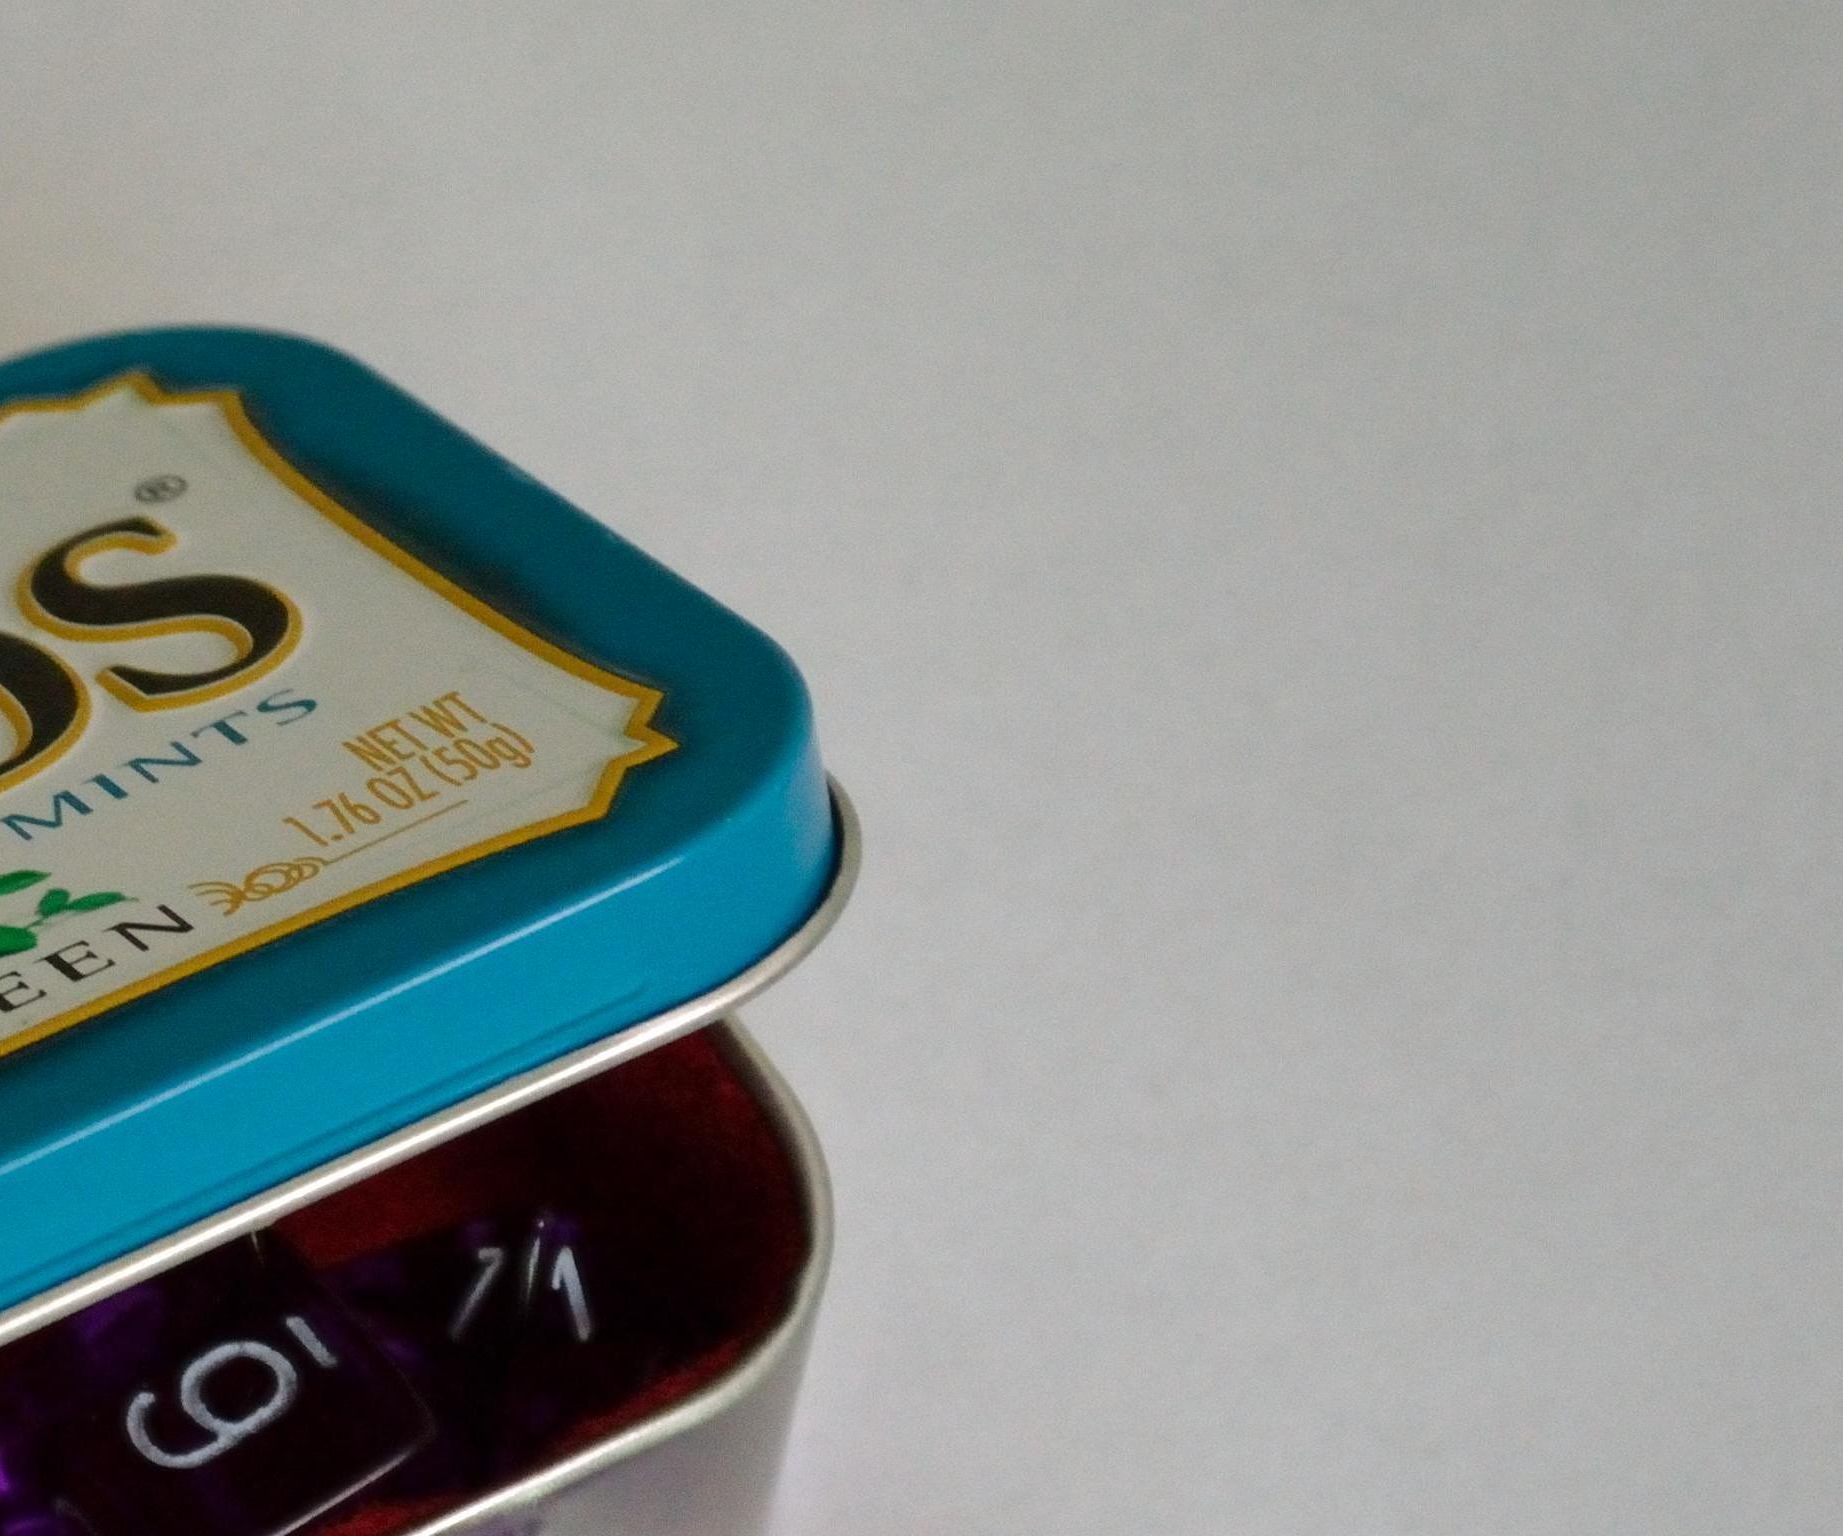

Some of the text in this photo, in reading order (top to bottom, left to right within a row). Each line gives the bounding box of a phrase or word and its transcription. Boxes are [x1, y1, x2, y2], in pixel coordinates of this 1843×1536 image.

[341, 691, 488, 772] NET WT
[282, 722, 535, 847] 1.76 OZ (50g)
